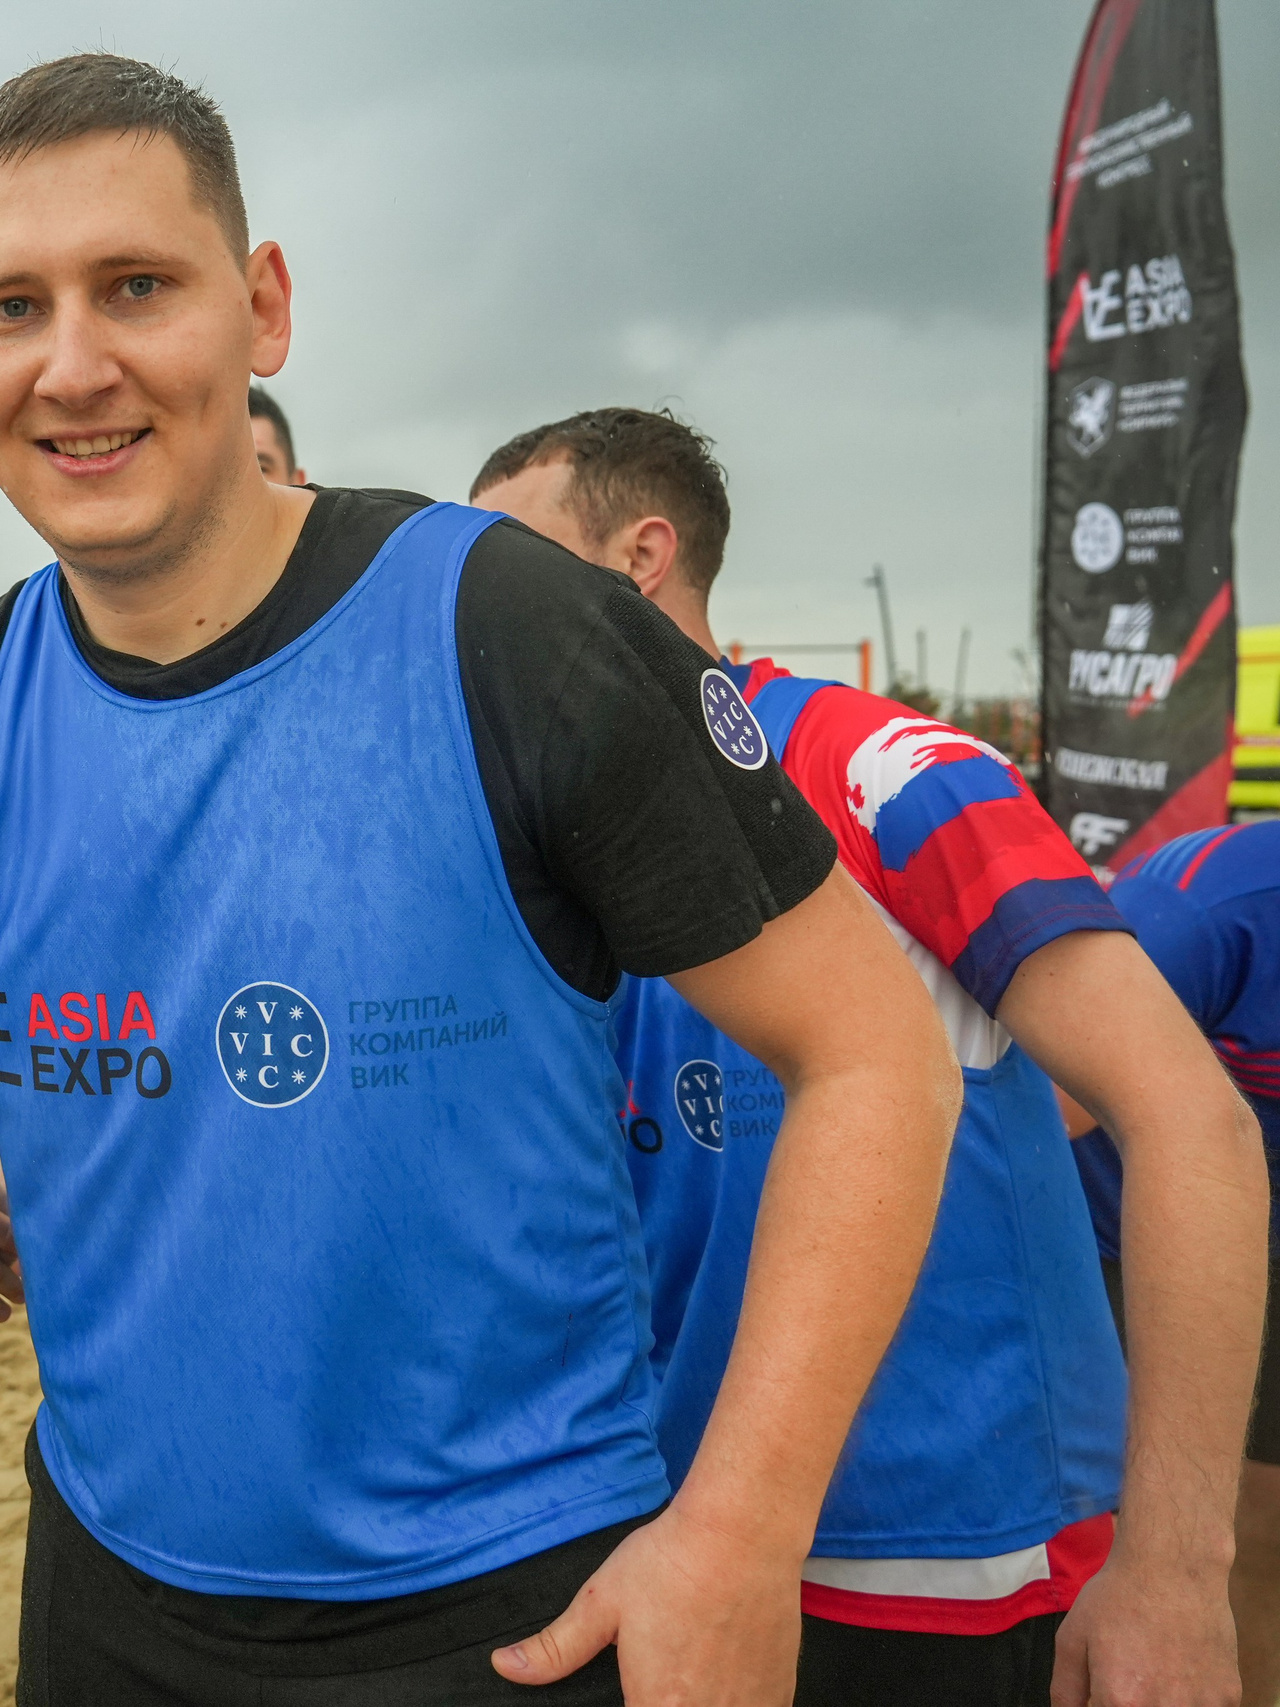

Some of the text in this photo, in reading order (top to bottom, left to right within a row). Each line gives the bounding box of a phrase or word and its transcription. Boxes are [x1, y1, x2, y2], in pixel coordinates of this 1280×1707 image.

[28, 991, 156, 1042] ASIA
[348, 994, 457, 1024] ГРУППА
[348, 1011, 508, 1056] КОМПАНИЙ
[30, 1045, 172, 1099] EXPO
[351, 1063, 409, 1089] ВИК
[723, 1068, 778, 1088] ГРУП
[729, 1117, 775, 1137] ВИК
